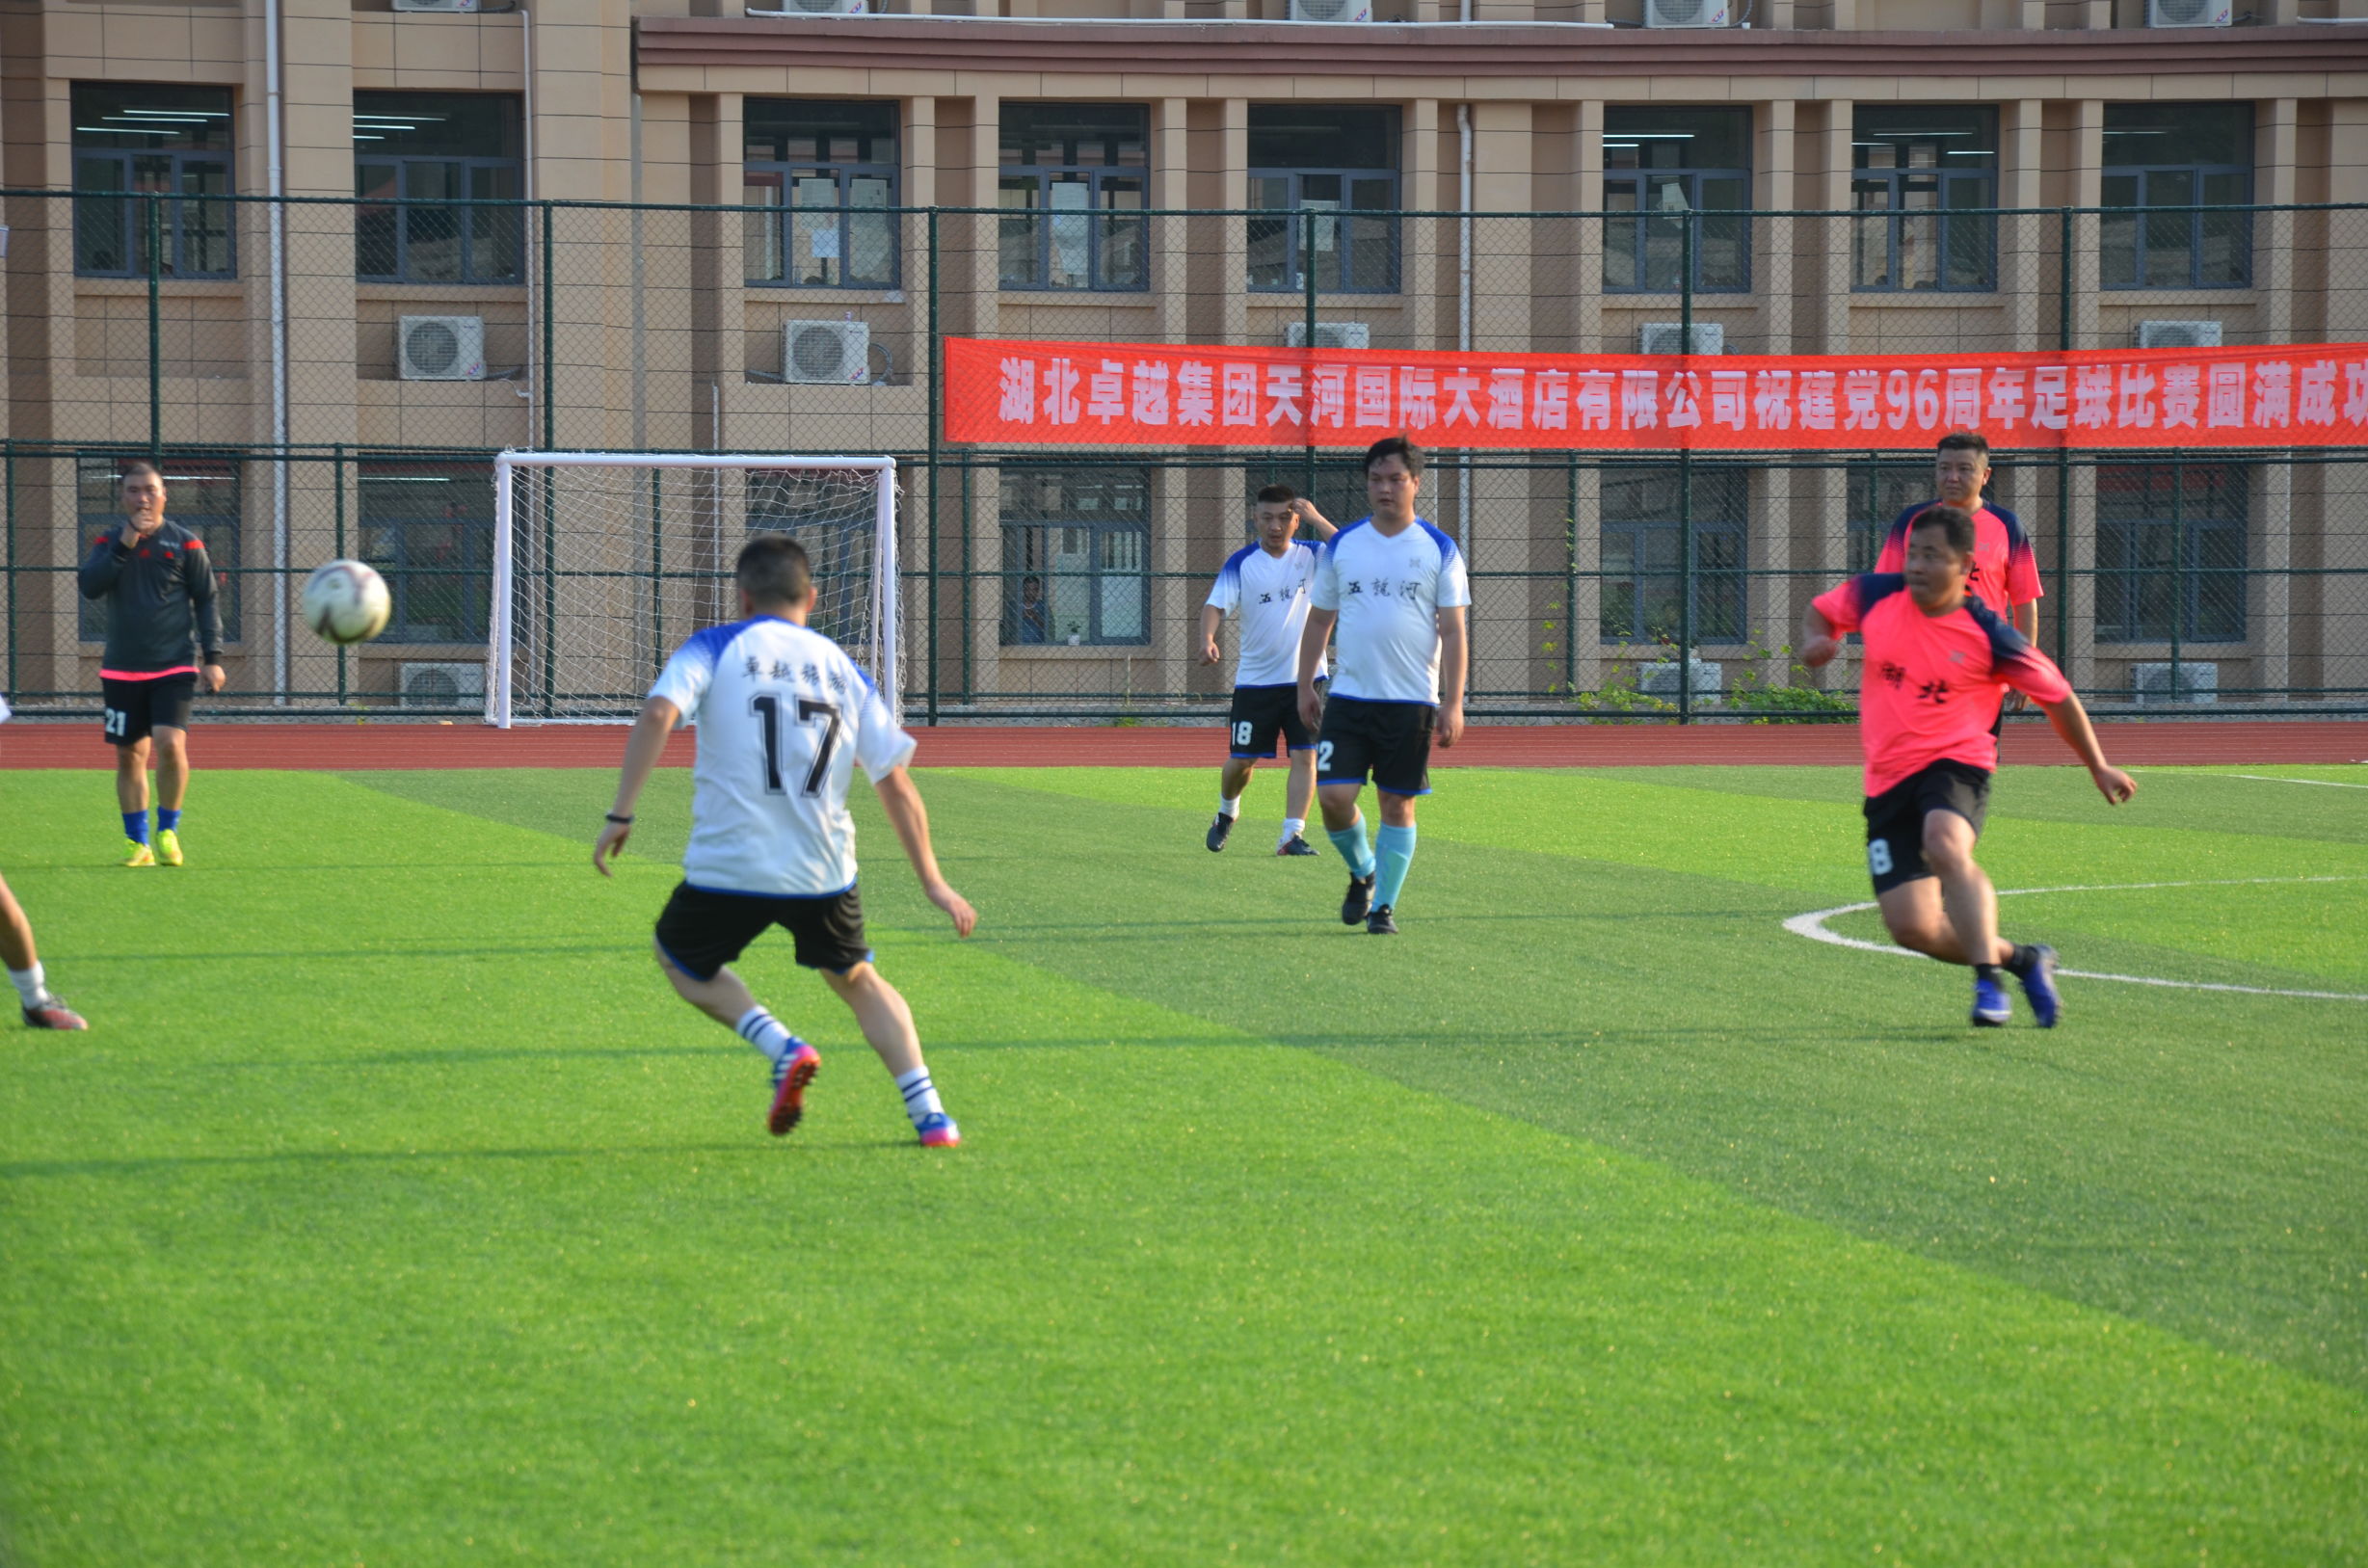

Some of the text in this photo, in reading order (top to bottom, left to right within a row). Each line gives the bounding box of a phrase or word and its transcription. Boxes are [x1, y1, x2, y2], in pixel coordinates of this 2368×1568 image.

[105, 707, 126, 737] 21
[1232, 721, 1253, 746] 18
[749, 691, 843, 798] 17
